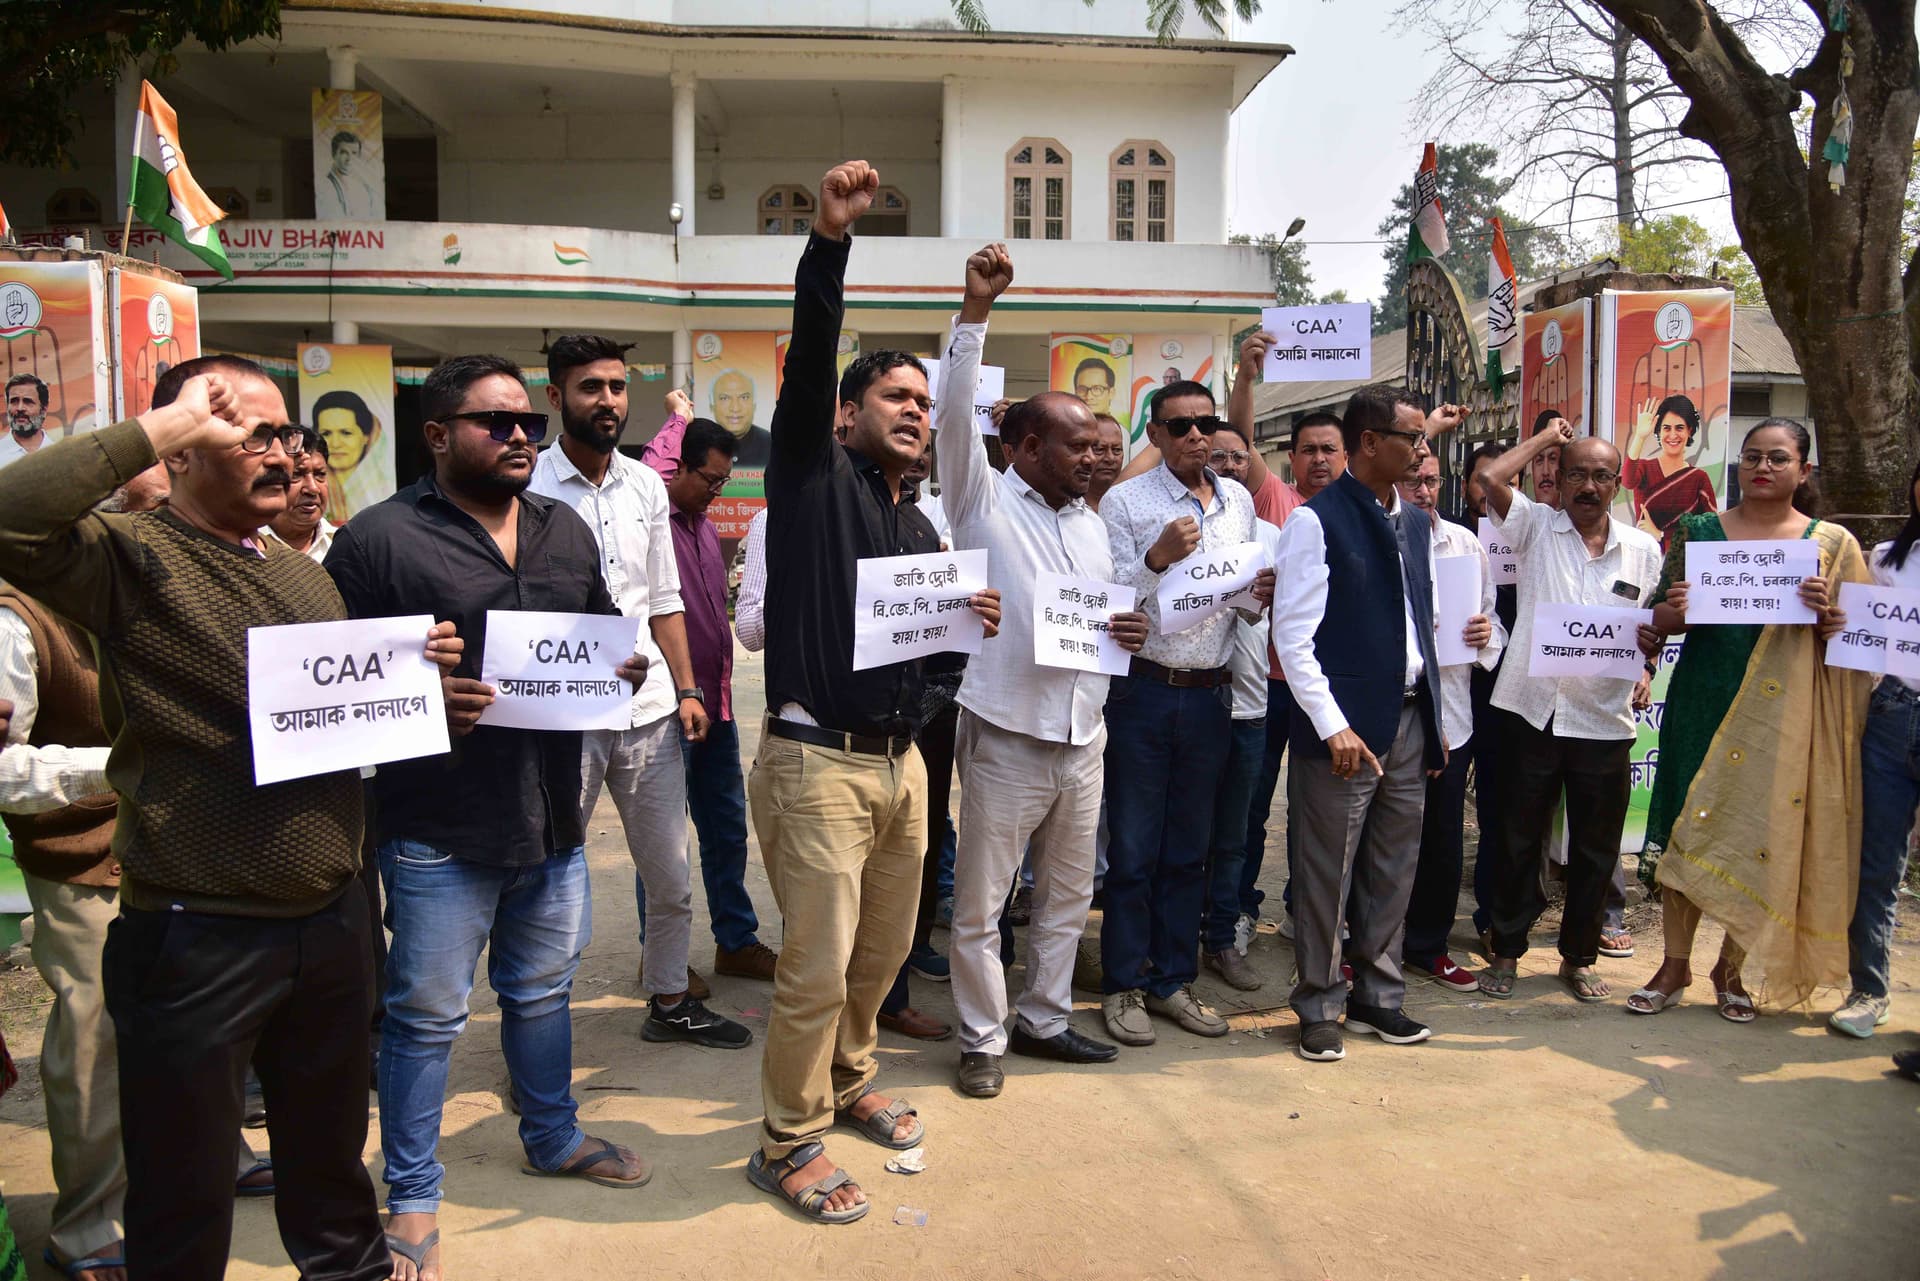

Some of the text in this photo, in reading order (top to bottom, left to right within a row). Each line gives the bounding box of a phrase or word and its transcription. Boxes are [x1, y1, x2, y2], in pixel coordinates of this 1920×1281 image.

[218, 229, 384, 249] AJIV BHAWAN
[1291, 318, 1343, 335] ‘CAA’
[1273, 345, 1360, 360] আমি নামানো
[1719, 550, 1750, 565] জাতি
[893, 568, 925, 587] জাতি
[1185, 560, 1239, 580] ‘CAA’
[1701, 572, 1758, 587] বি.জে.পি.
[1059, 587, 1081, 603] জাতি
[1172, 592, 1214, 612] বাতিল
[1720, 598, 1781, 610] হায়! হায়!
[873, 597, 932, 618] বি.জে.পি.
[1045, 607, 1085, 630] বি.জে.পি.
[892, 625, 948, 644] হায়! হায়!
[1563, 621, 1622, 639] ‘CAA’
[1059, 638, 1099, 657] হায়! হায়!
[1842, 629, 1888, 651] বাতিল
[528, 639, 599, 664] ‘CAA’
[1541, 645, 1636, 660] আমাক নালাগে
[302, 651, 393, 686] ‘CAA’
[498, 679, 621, 697] আমাক নালাগে
[270, 695, 428, 732] আমাক নালাগে
